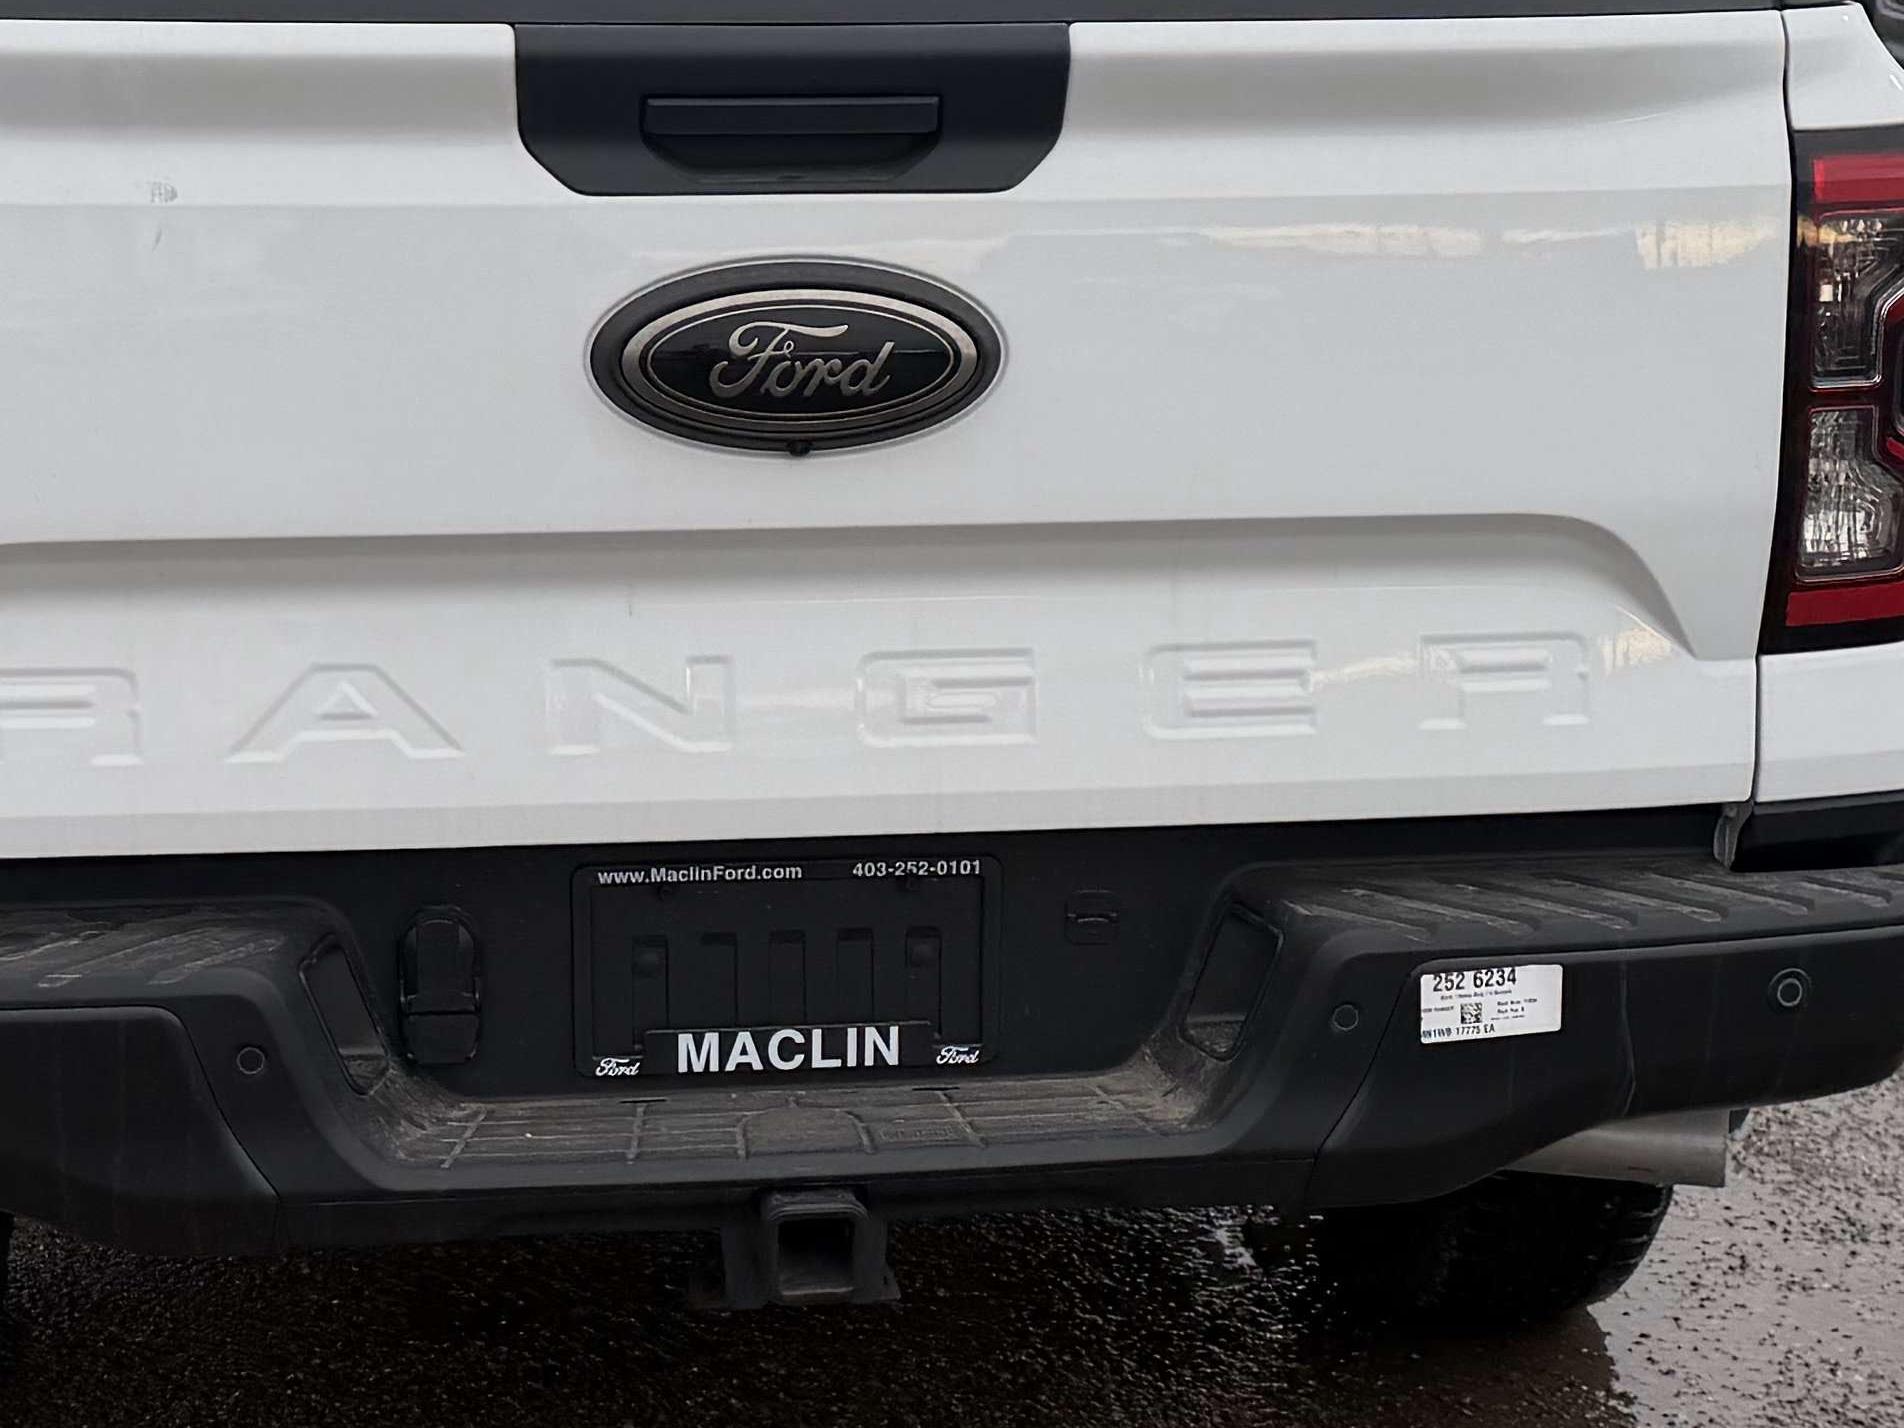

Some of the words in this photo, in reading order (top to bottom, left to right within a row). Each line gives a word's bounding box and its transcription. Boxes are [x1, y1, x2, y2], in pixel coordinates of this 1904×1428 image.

[709, 321, 895, 398] Ford
[597, 865, 803, 886] www.MaclinFord.com
[852, 860, 980, 878] 403-252-0101
[1432, 971, 1466, 992] 252
[1473, 968, 1517, 989] 6234
[1484, 1023, 1496, 1034] EA
[677, 1026, 900, 1073] MACLIN
[935, 1045, 979, 1065] Ford
[596, 1056, 640, 1077] Ford
